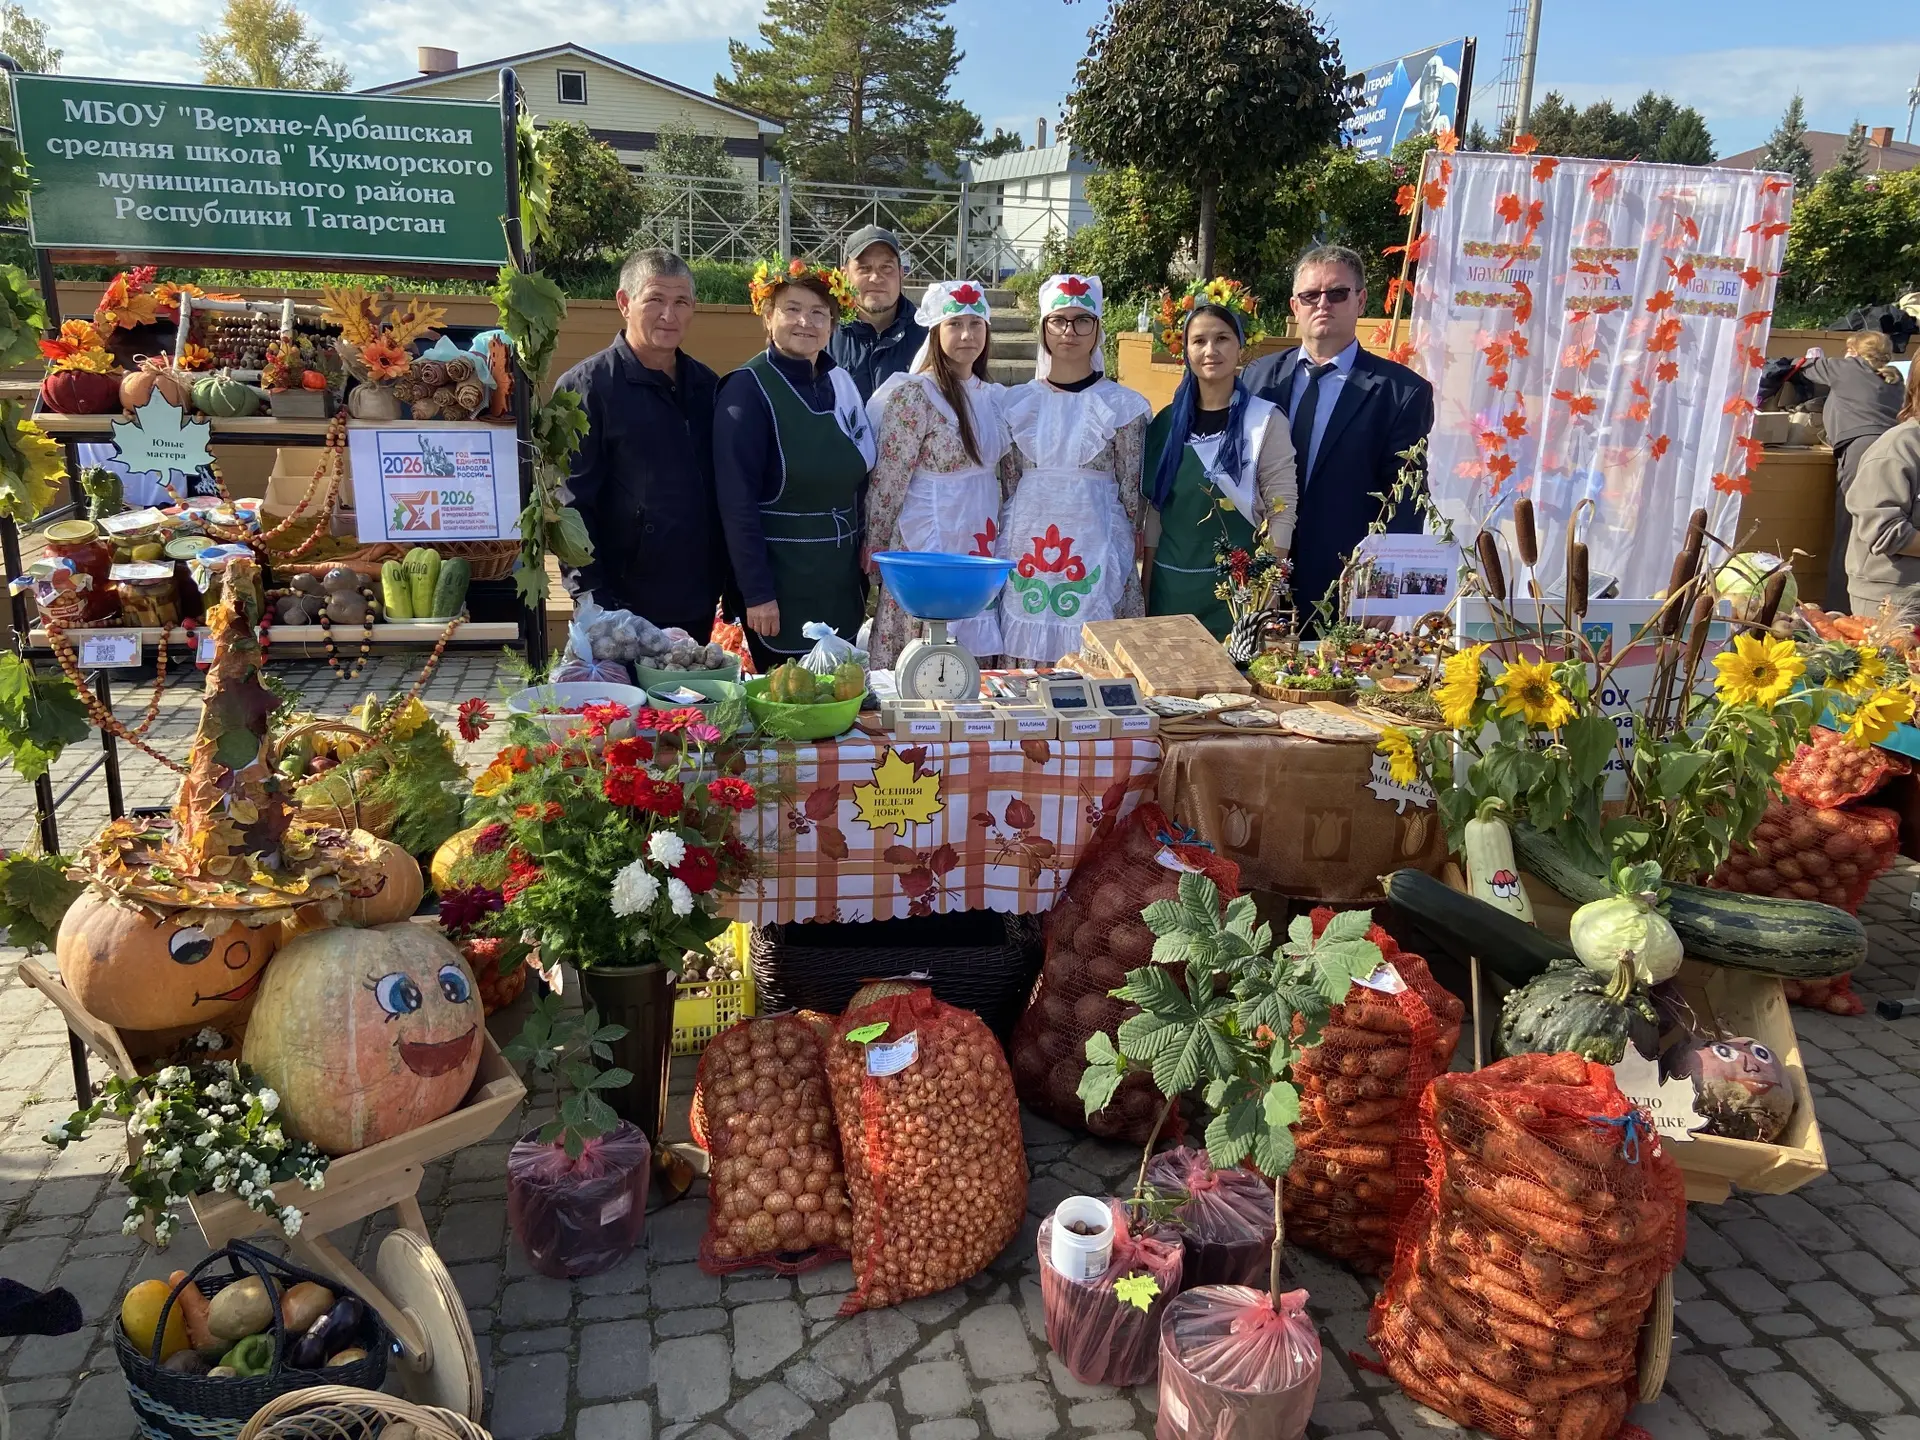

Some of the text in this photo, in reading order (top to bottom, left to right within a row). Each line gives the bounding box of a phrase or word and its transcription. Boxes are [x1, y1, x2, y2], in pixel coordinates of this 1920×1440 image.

[62, 98, 473, 145] МБОУ "Верхне-Арбашская
[46, 137, 493, 177] средняя школа" Кукморского
[97, 171, 456, 205] муниципального района
[114, 197, 447, 235] Республики Татарстан
[1583, 277, 1621, 291] УРТА
[152, 439, 185, 449] Юные
[146, 451, 186, 460] мастера
[383, 456, 423, 474] 2026
[440, 490, 475, 505] 2026
[1374, 774, 1436, 798] МАСТЕРСКА
[874, 798, 914, 806] НЕДЕЛЯ
[873, 808, 905, 817] ДОБРА
[1626, 1096, 1662, 1109] УДО
